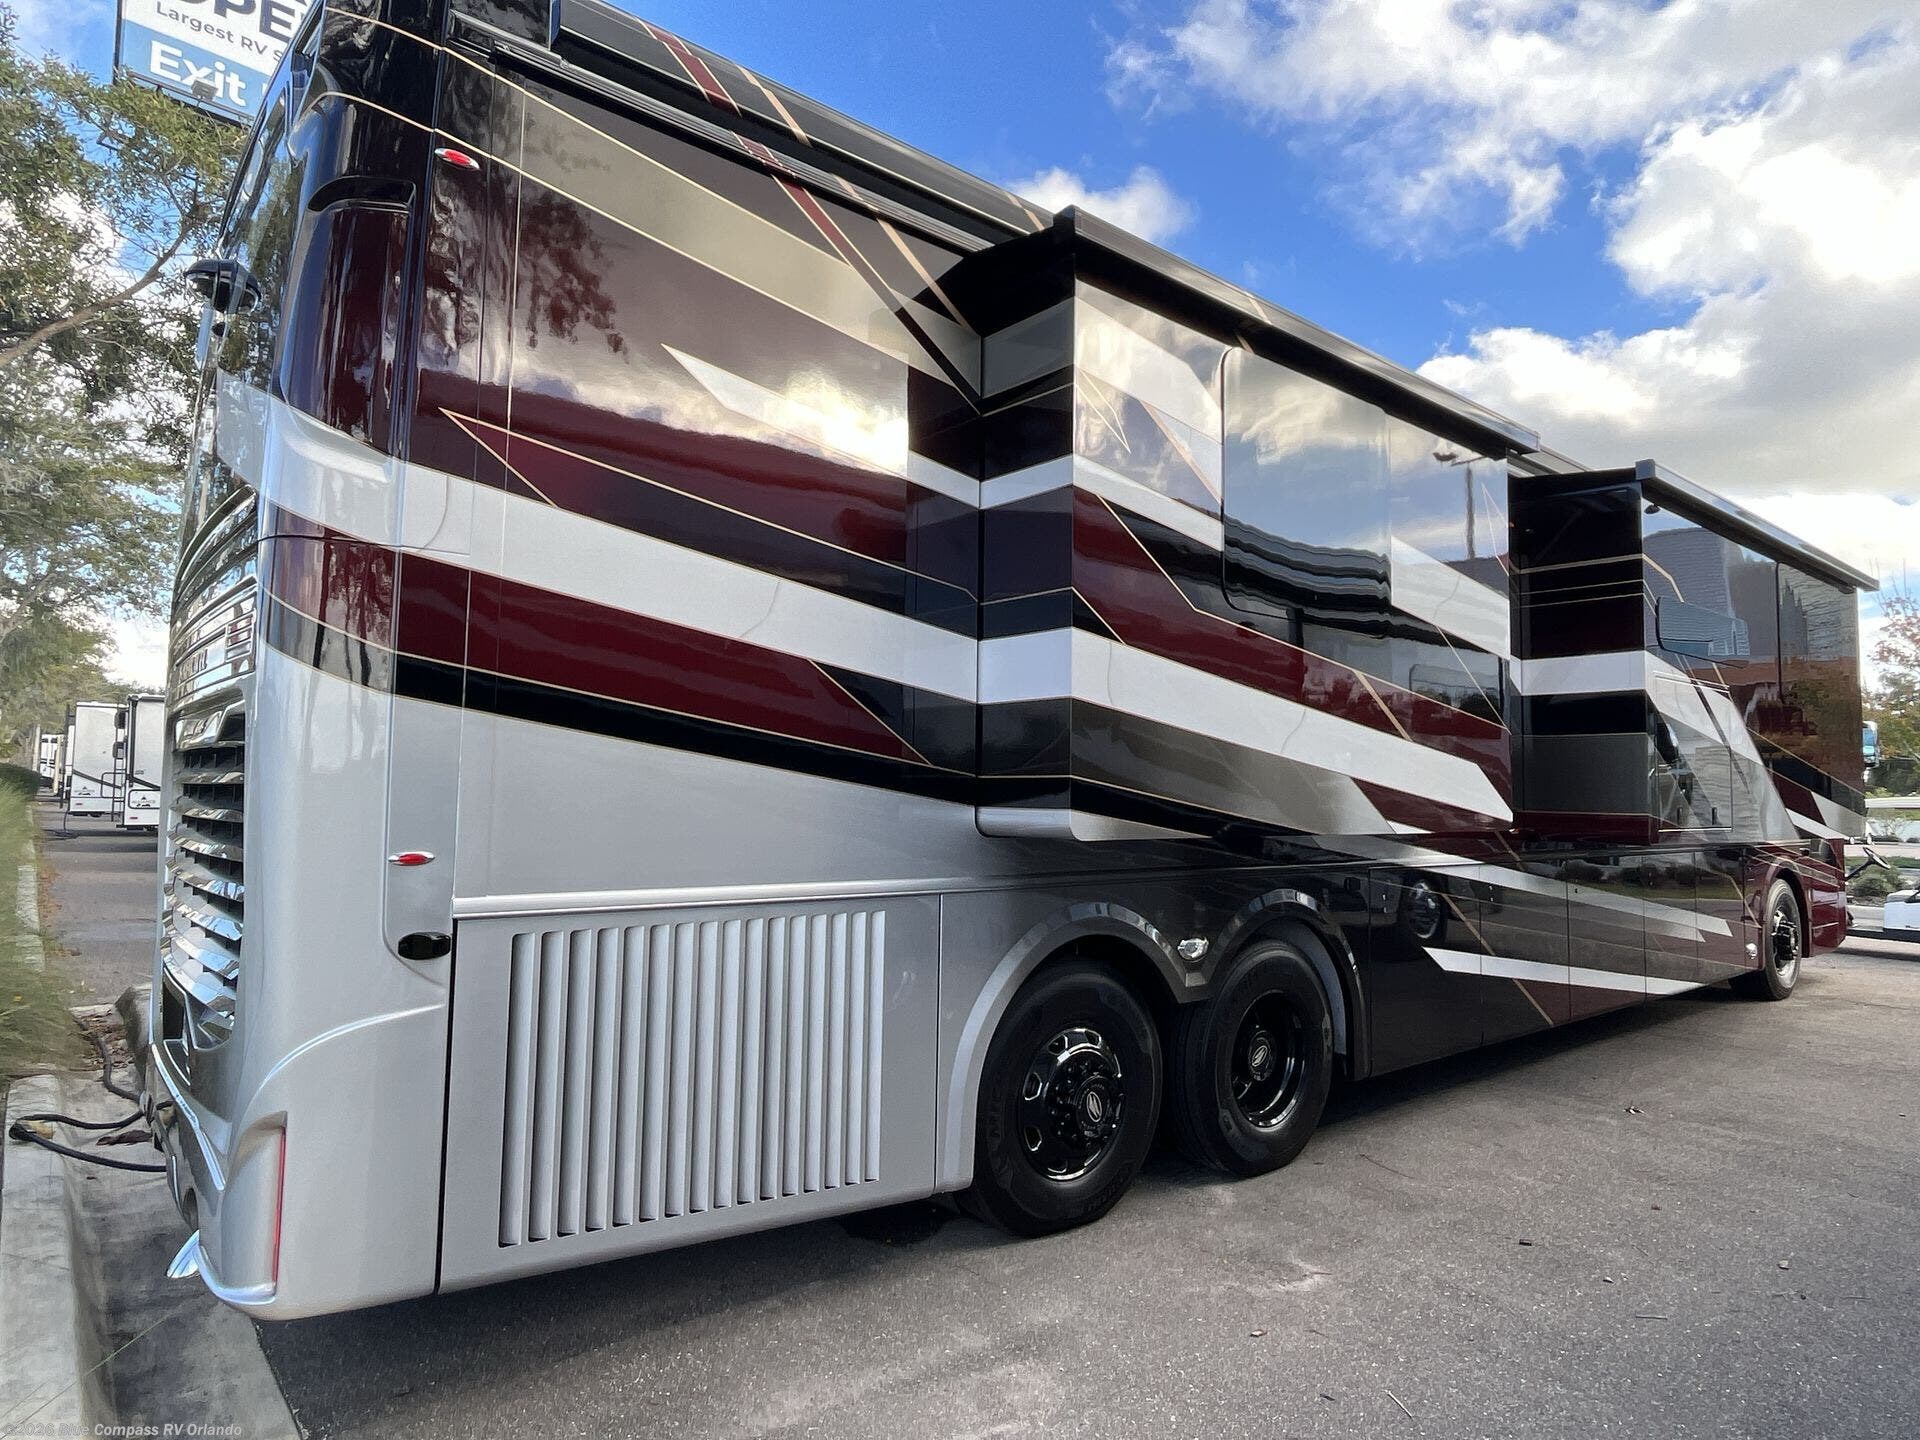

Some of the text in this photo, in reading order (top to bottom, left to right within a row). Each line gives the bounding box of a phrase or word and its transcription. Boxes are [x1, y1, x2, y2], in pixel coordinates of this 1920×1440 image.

[156, 1, 235, 44] Largest
[241, 35, 269, 54] RV
[150, 40, 247, 108] Exit
